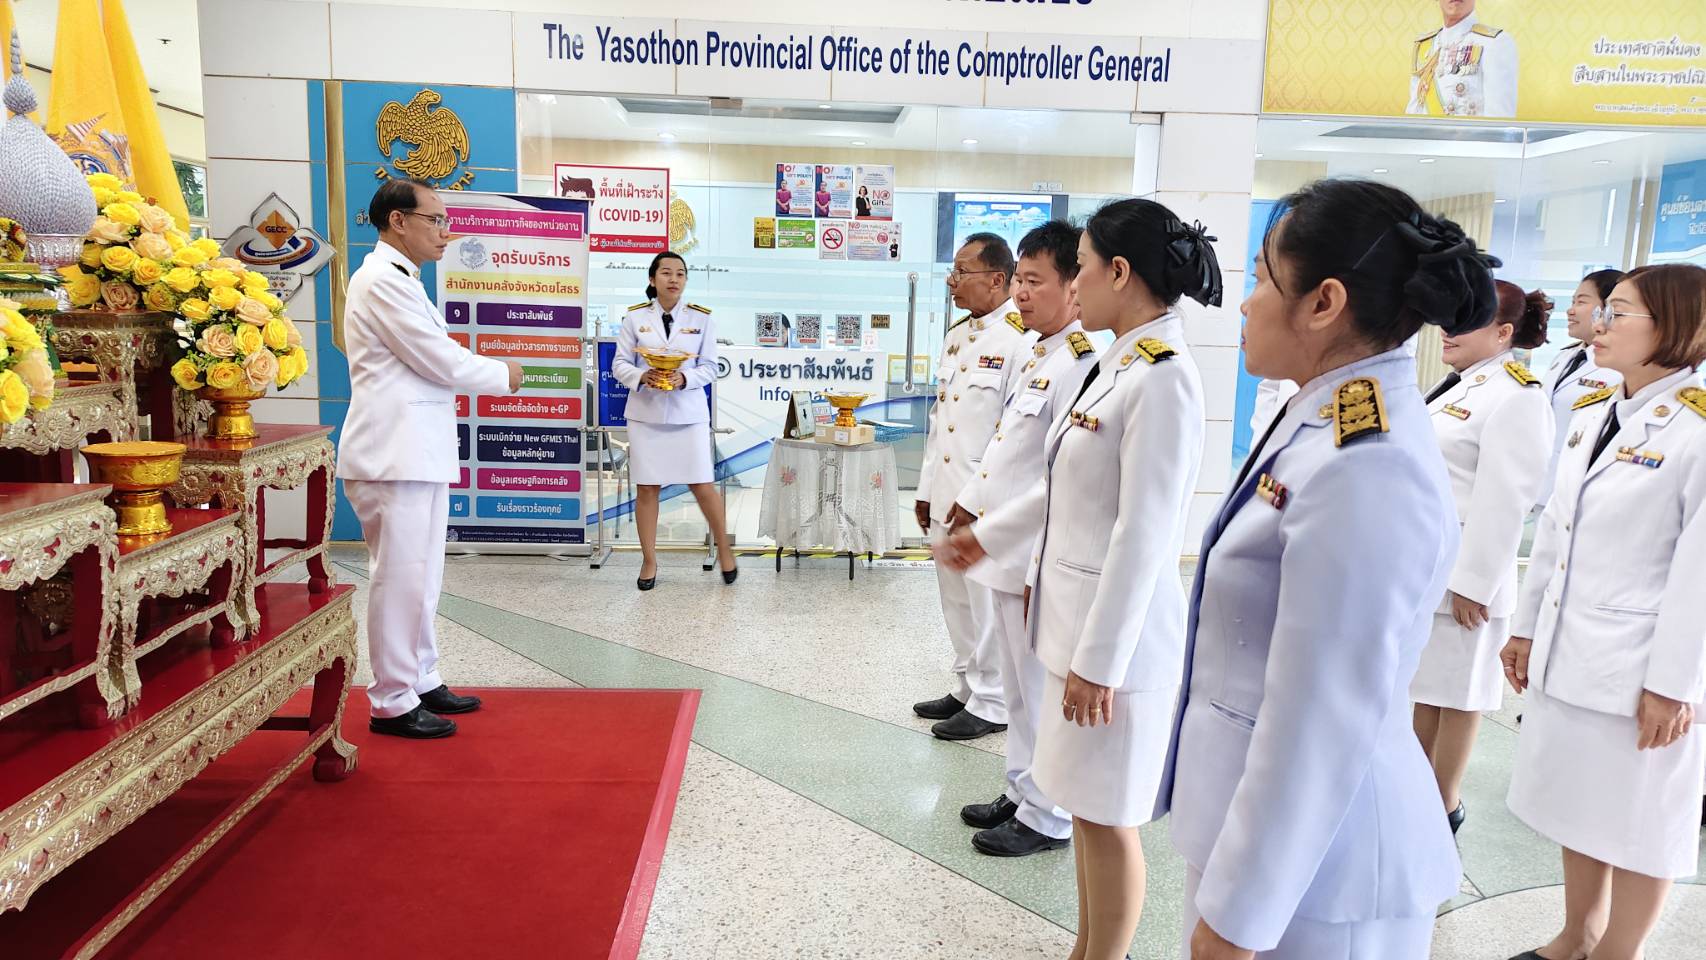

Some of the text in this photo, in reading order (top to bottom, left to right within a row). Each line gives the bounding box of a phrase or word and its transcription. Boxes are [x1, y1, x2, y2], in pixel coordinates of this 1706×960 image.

[543, 23, 1171, 85] The Yasothon Provincial Office of the Comptroller General
[600, 177, 664, 199] พื้นที่เฝ้าระวัง
[600, 208, 664, 223] (COVID-19)
[491, 249, 571, 268] จุดรับบริการ
[446, 278, 580, 294] สำนักงานคลังจังหวัดยโสธร
[506, 309, 554, 321] ประชาสัมพันธ์
[739, 356, 874, 381] ประชาสัมพันธ์
[522, 373, 568, 384] หมายระเบียบ
[550, 404, 569, 414] e-GP
[479, 431, 579, 444] ระบบเบิกจ่าย New GFMIS Thai
[502, 447, 555, 460] ข้อมูลหลักผู้ขาย
[490, 473, 568, 487] ข้อมูลเศรษฐกิจการคลัง
[496, 500, 562, 515] รับเรื่องราวร้องทุกข์
